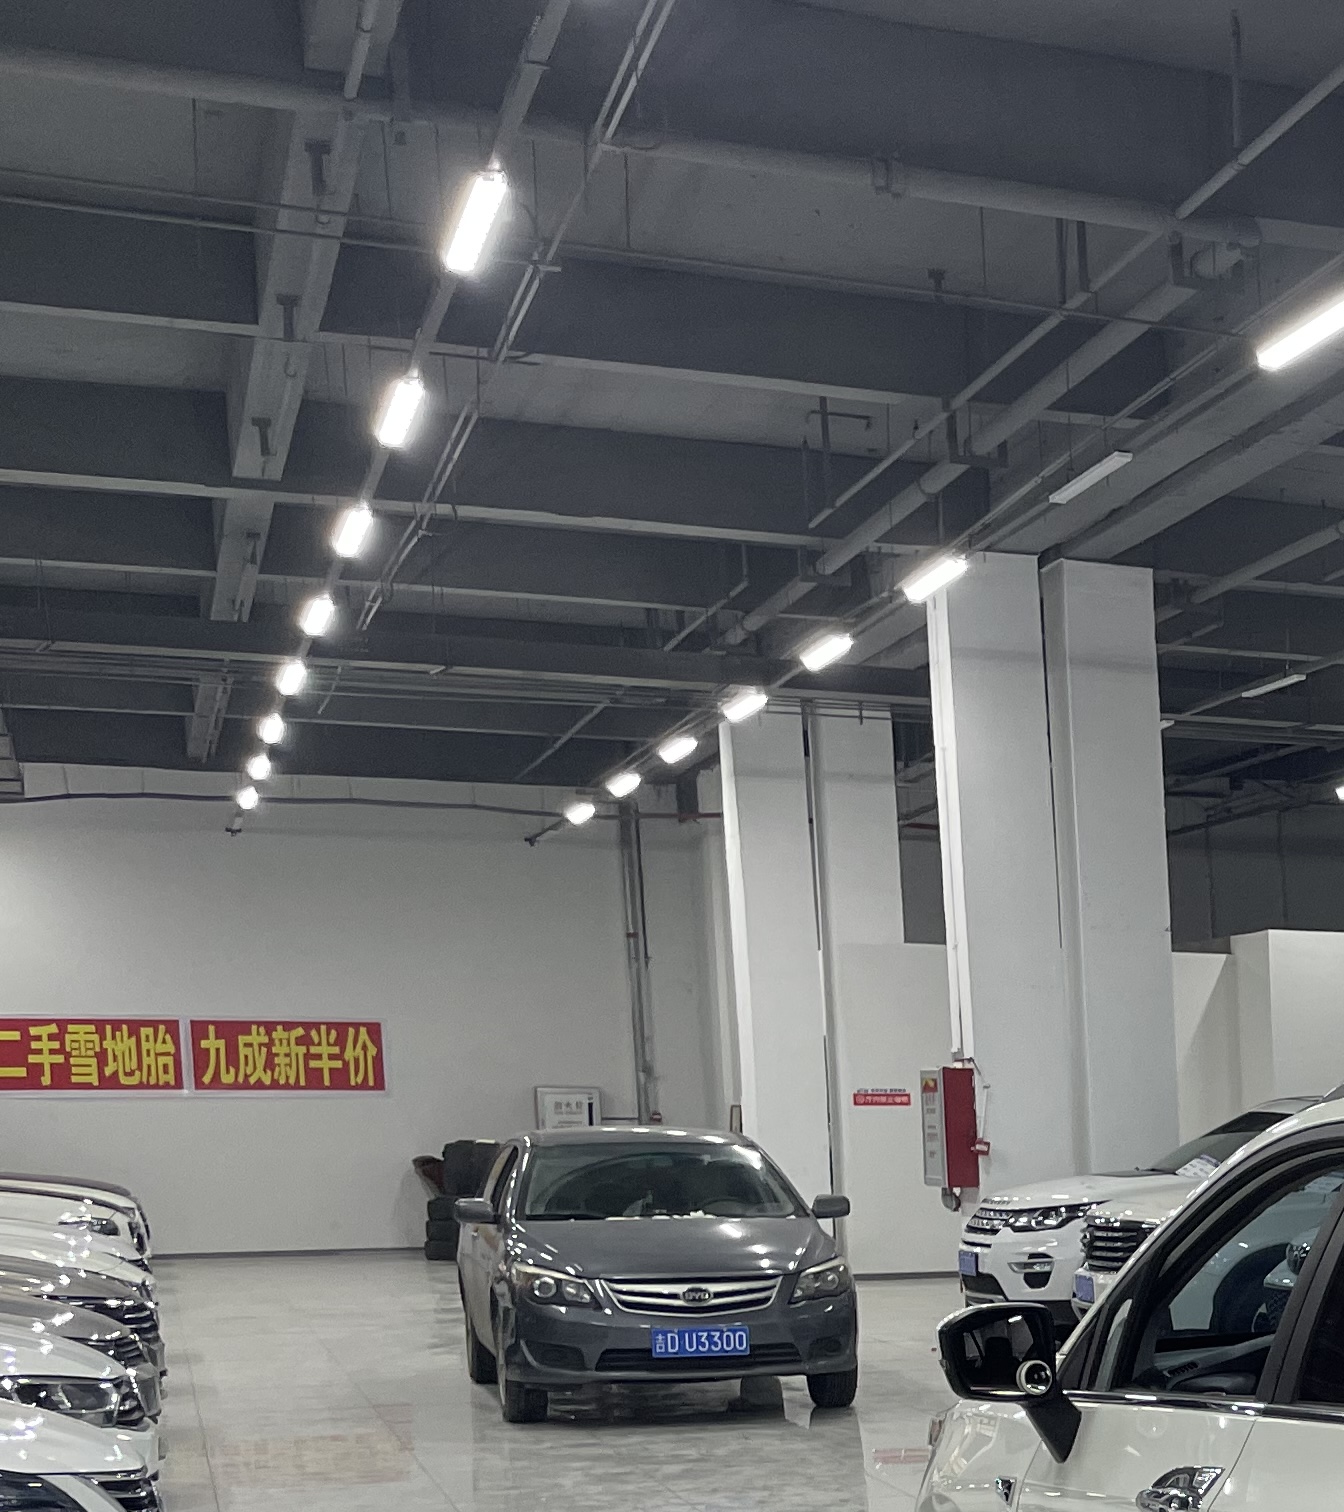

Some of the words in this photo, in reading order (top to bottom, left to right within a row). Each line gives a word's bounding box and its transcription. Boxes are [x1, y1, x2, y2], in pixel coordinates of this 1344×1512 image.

[0, 1023, 176, 1087] 二手雪地胎
[200, 1022, 378, 1087] 九成新半价
[684, 1290, 710, 1300] BYD
